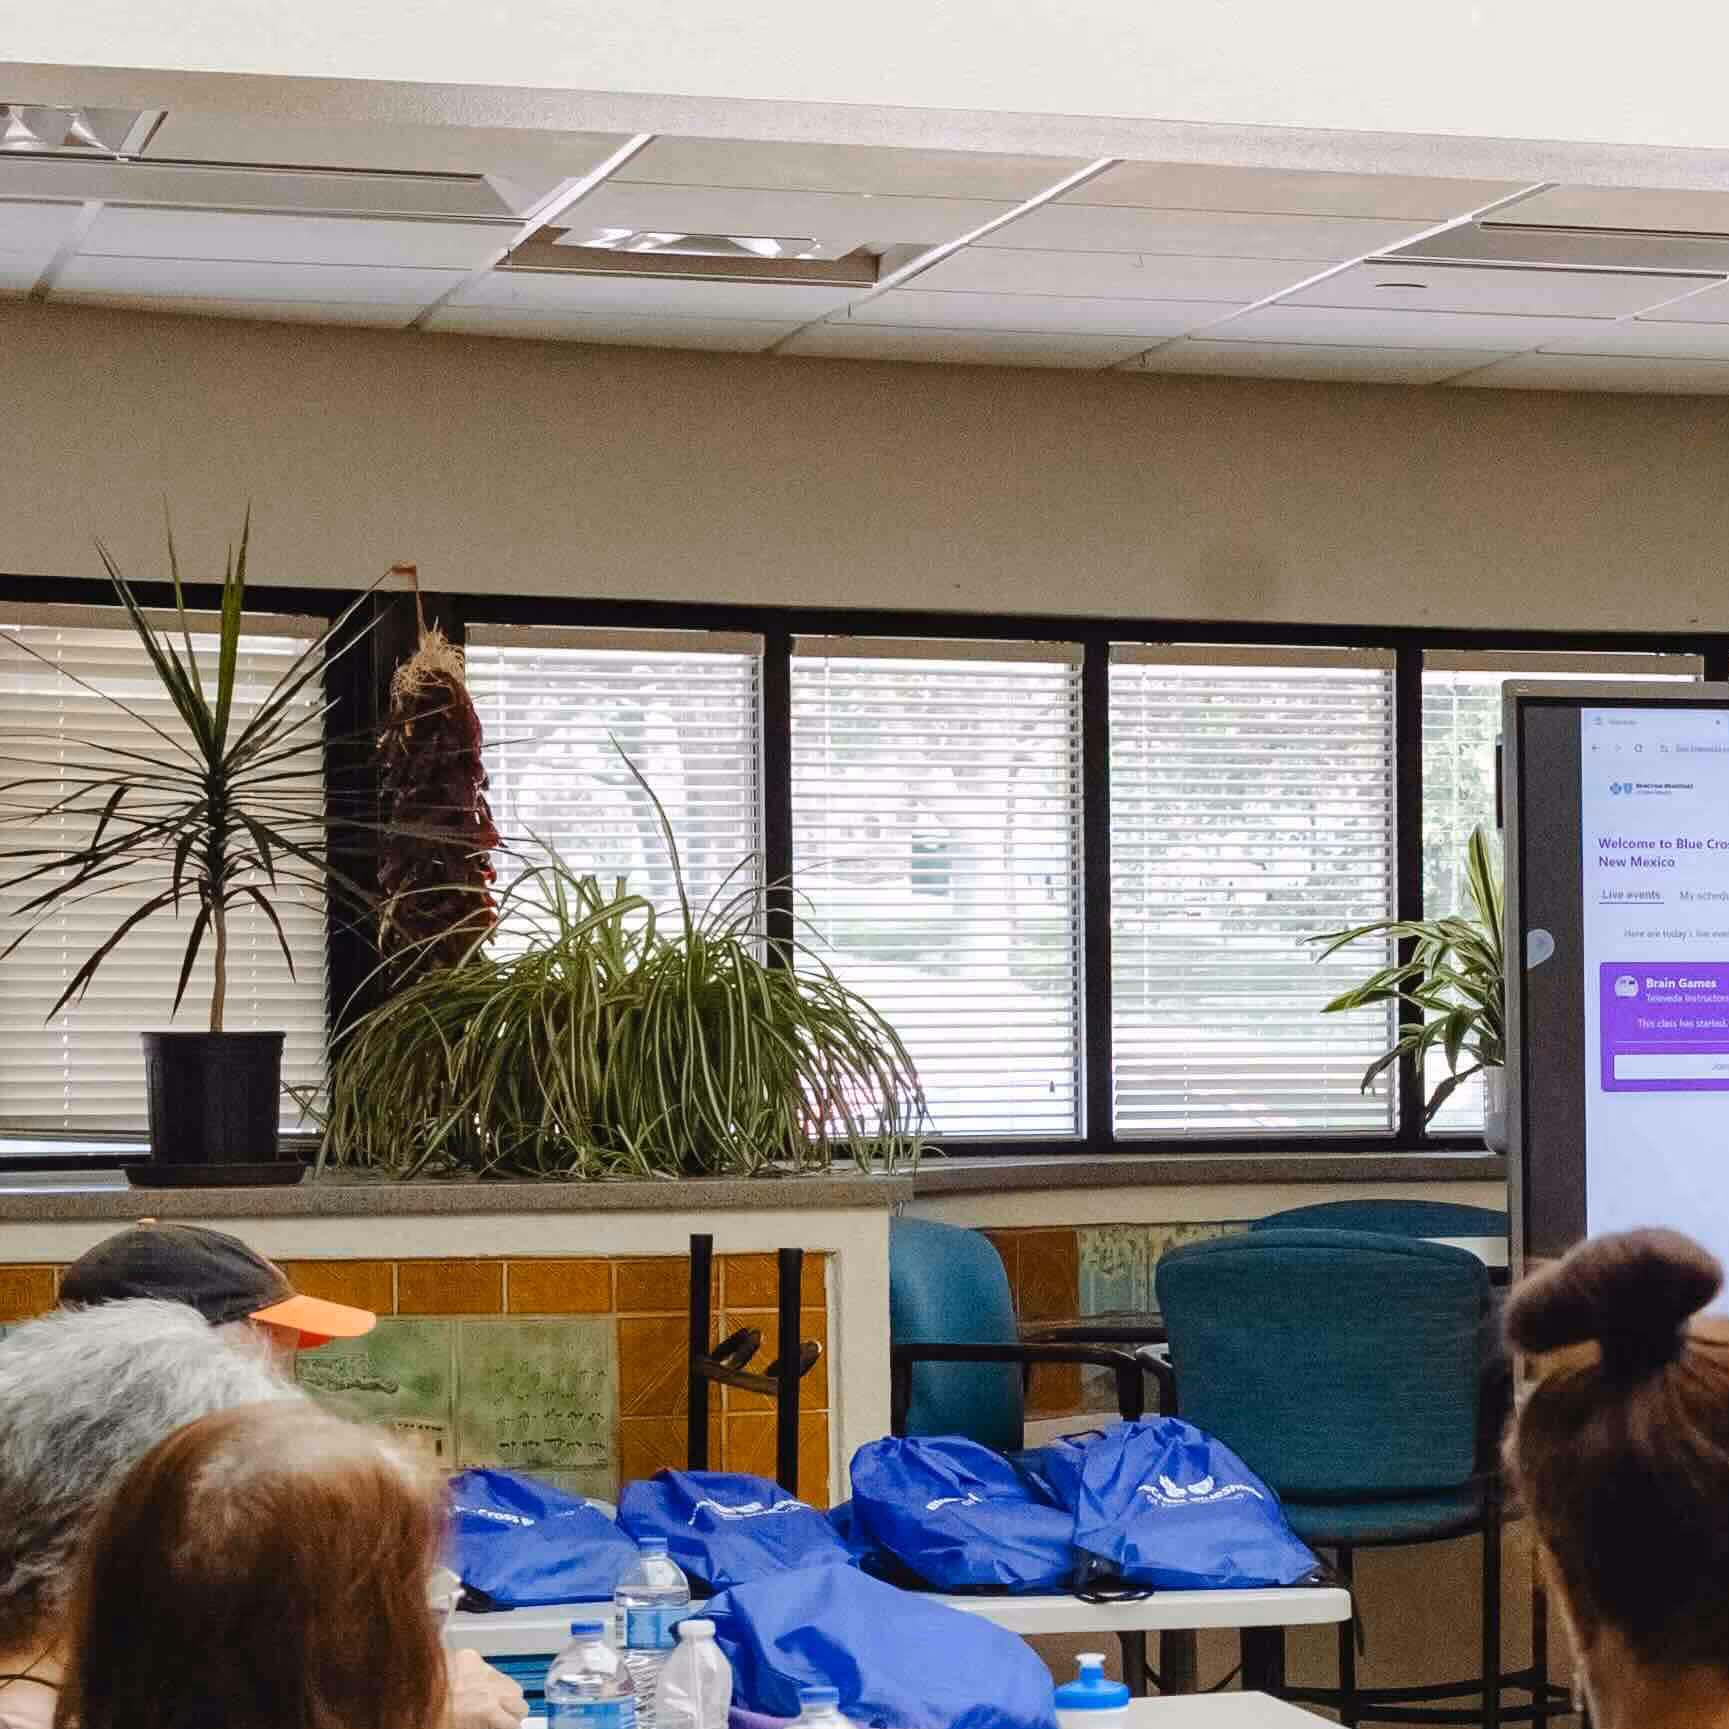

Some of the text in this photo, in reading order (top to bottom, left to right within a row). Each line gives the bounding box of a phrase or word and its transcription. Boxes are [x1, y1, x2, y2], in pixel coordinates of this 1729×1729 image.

[1598, 838, 1655, 850] Welcome
[1660, 839, 1673, 850] to
[1676, 838, 1702, 850] Blue
[1599, 856, 1676, 868] New Mexico
[1602, 889, 1661, 900] Live events
[1679, 890, 1695, 903] My
[1646, 977, 1718, 989] Brain Games
